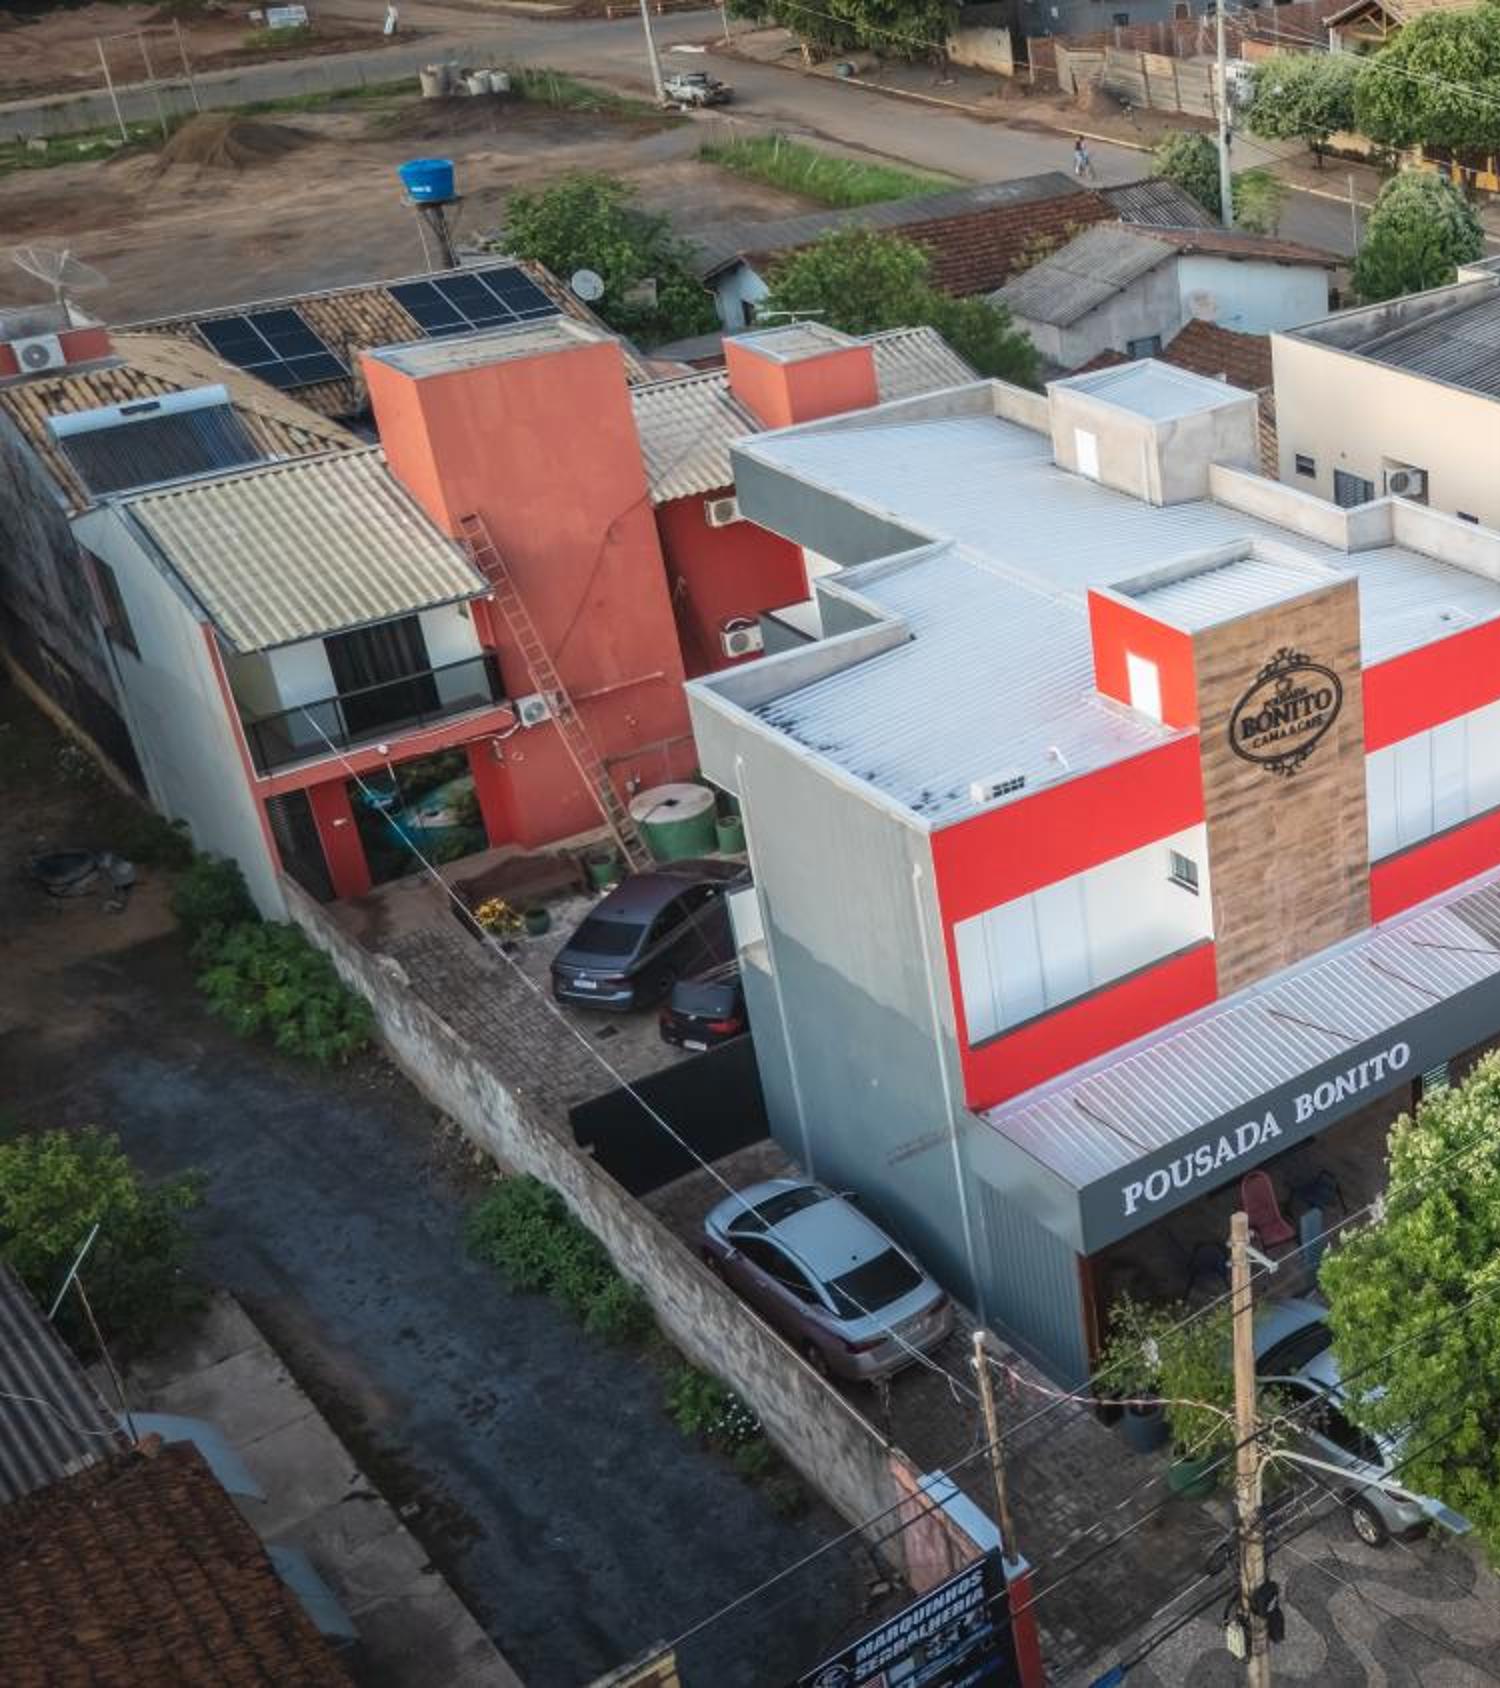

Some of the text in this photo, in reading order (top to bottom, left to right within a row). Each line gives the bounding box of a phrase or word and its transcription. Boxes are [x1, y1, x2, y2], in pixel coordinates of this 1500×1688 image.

[1241, 688, 1332, 739] BONITO
[1120, 1042, 1412, 1218] POUSADA BONITO
[854, 1587, 985, 1681] SERRALHERIA
[855, 1569, 984, 1663] MARQUINHOS
